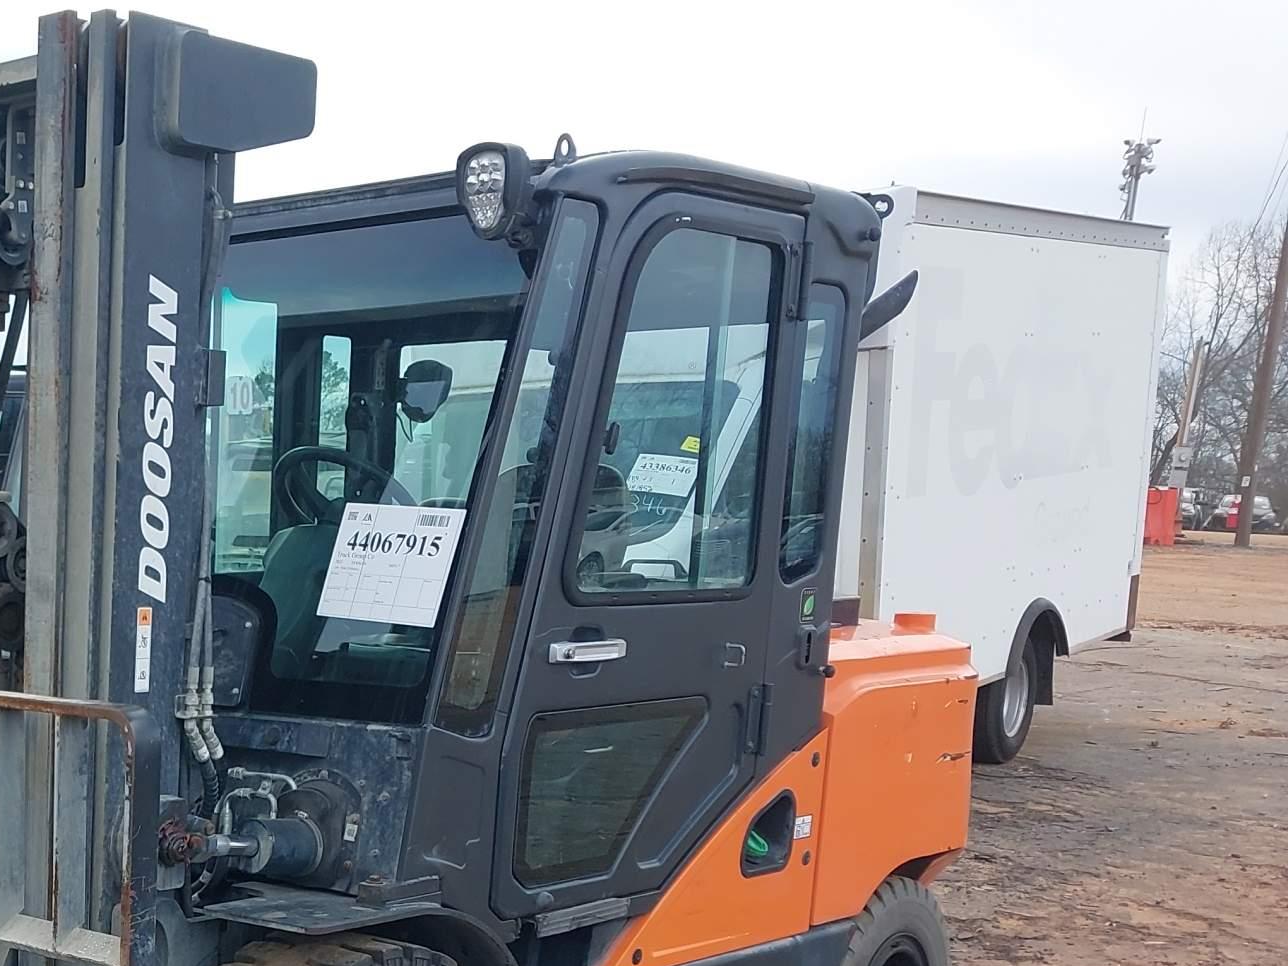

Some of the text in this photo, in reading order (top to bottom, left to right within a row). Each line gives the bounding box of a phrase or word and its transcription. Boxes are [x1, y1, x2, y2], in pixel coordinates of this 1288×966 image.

[230, 381, 250, 410] 10
[138, 273, 178, 603] DOOSAN
[346, 530, 443, 557] 44067915
